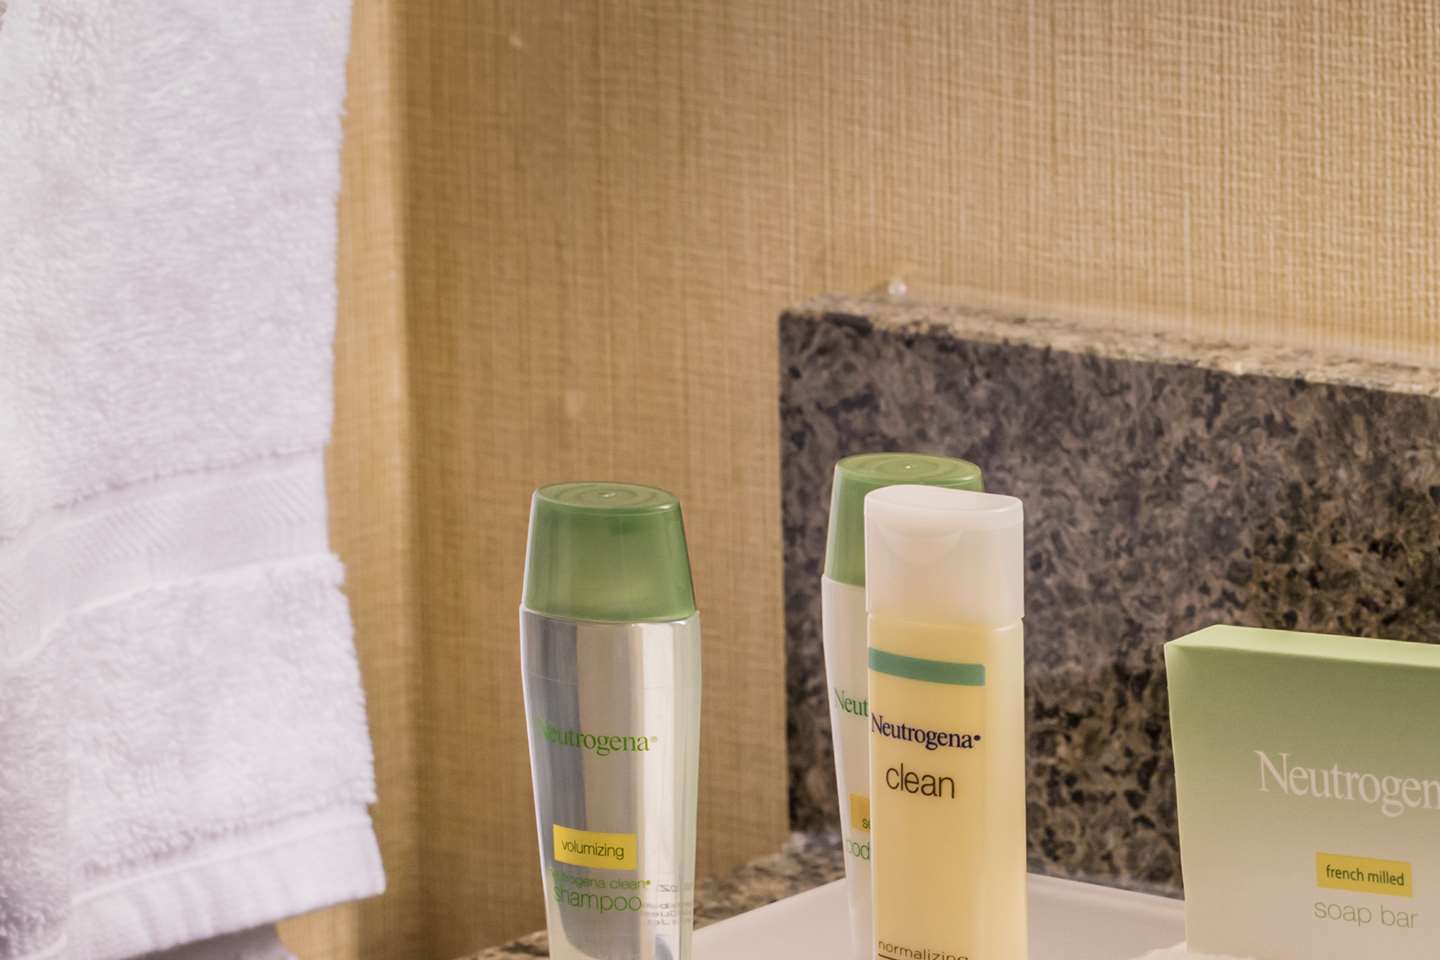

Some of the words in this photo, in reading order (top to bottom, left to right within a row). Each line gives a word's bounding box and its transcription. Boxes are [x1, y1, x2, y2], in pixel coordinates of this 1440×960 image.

[886, 762, 955, 799] clean
[561, 838, 625, 861] volumizing
[1326, 864, 1364, 882] french
[1367, 870, 1405, 886] milled
[1313, 901, 1372, 927] soap
[1380, 903, 1419, 929] bar
